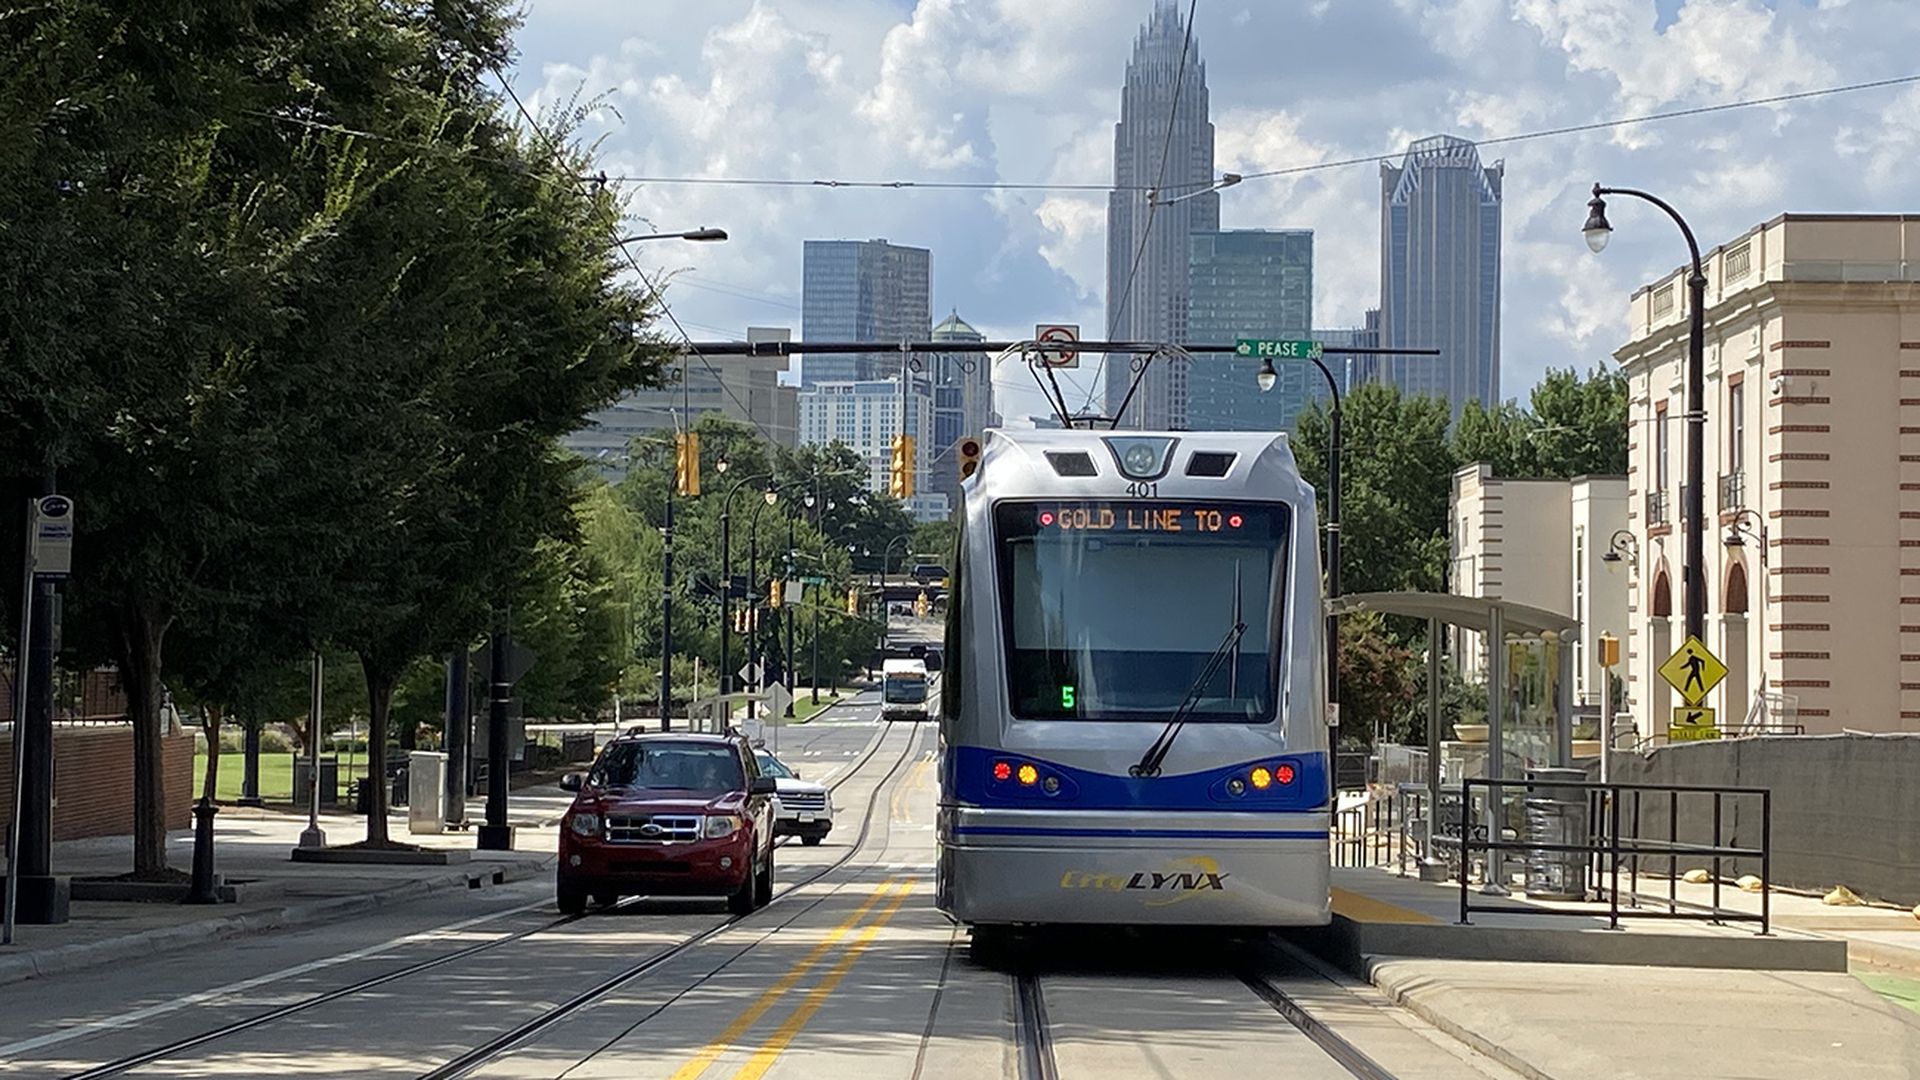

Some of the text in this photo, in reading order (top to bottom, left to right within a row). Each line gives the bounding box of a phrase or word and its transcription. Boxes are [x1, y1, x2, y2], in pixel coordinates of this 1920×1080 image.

[1420, 157, 1469, 168] TRUIST
[1258, 342, 1298, 357] PEASE
[1126, 482, 1157, 498] 401
[1057, 509, 1222, 531] GOLD LINE TO
[1062, 686, 1075, 708] 5
